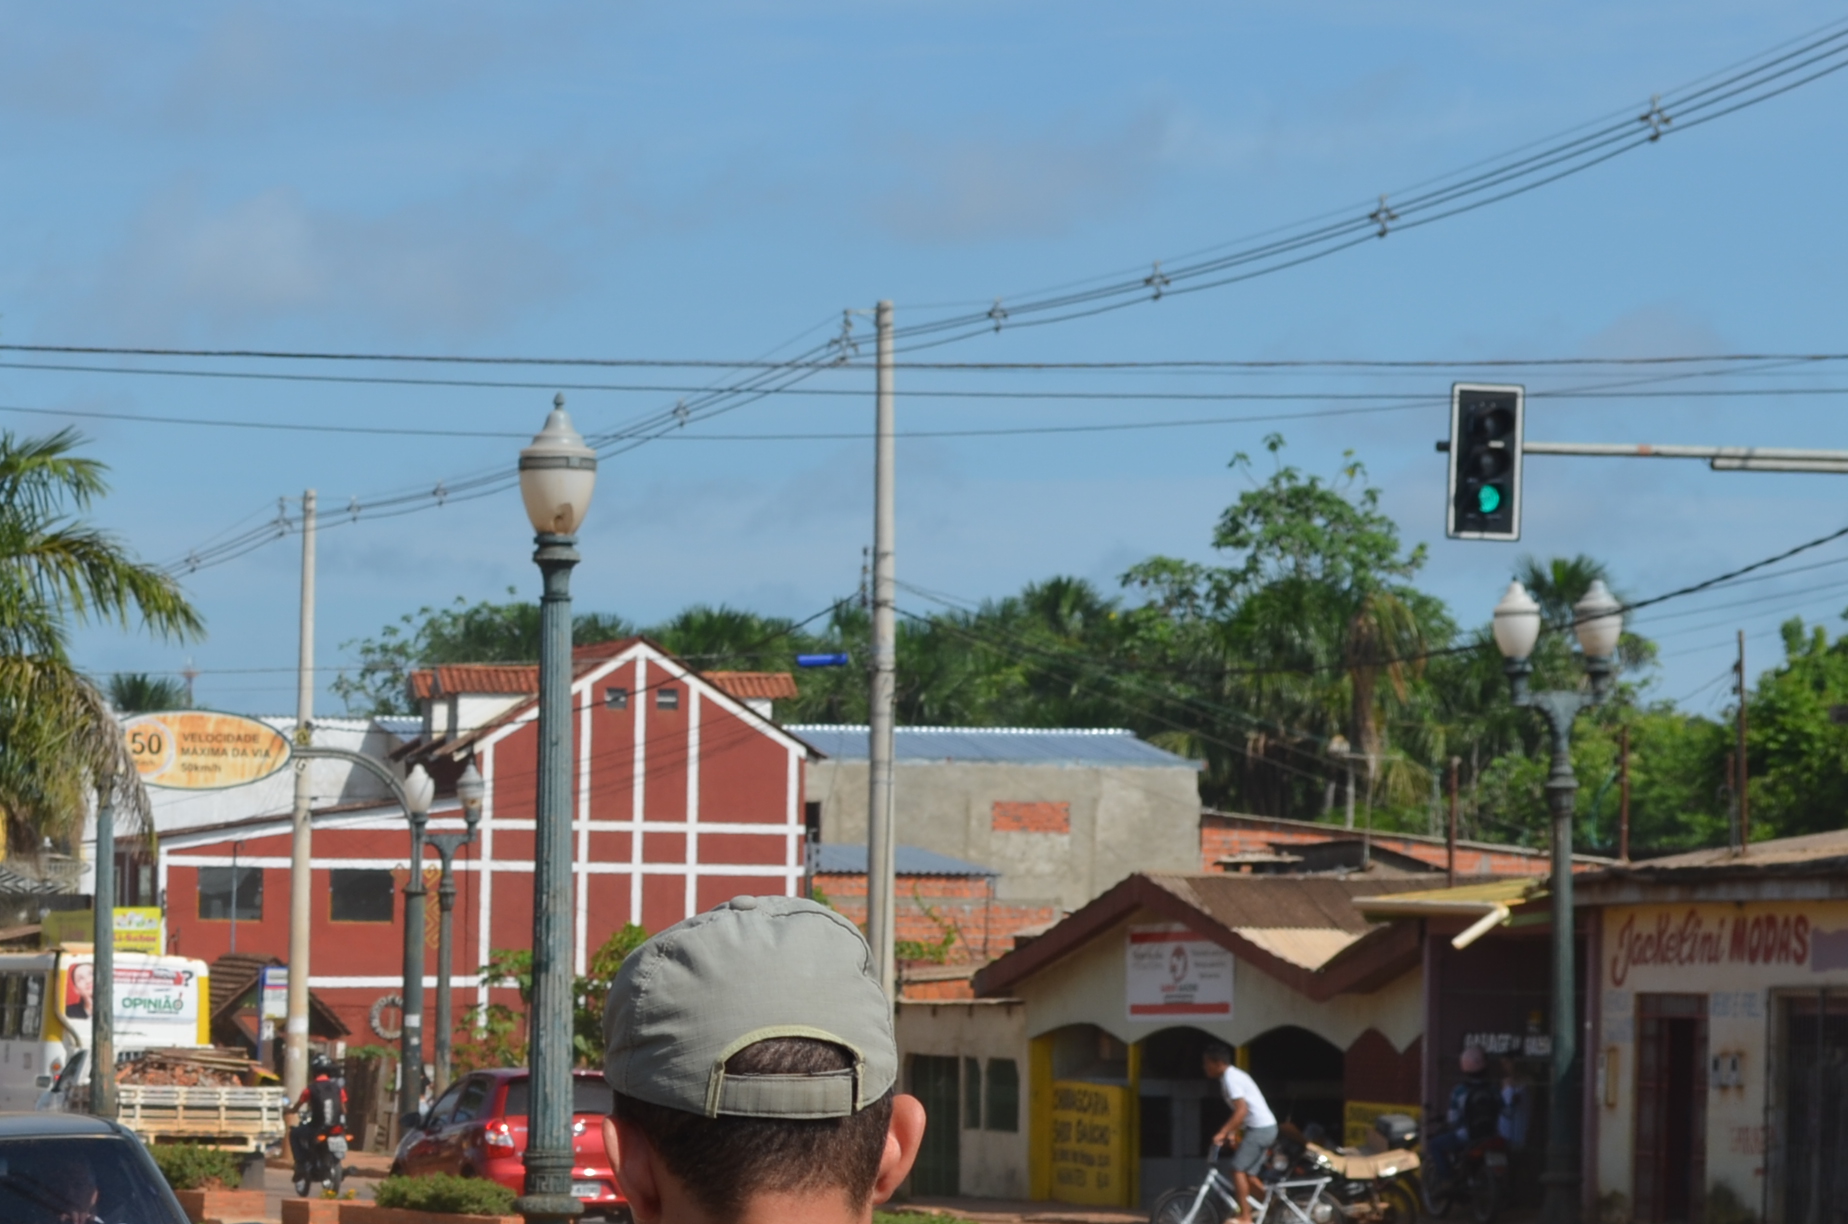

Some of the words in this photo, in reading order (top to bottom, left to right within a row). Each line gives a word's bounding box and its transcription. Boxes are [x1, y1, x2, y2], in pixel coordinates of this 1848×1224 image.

[131, 732, 162, 755] 50
[182, 733, 260, 744] VELOCIDADE
[231, 747, 249, 758] DA
[252, 749, 272, 759] VIA
[181, 763, 222, 772] 50km/h
[1729, 914, 1810, 966] MODAS
[122, 995, 183, 1011] OPINIÃO
